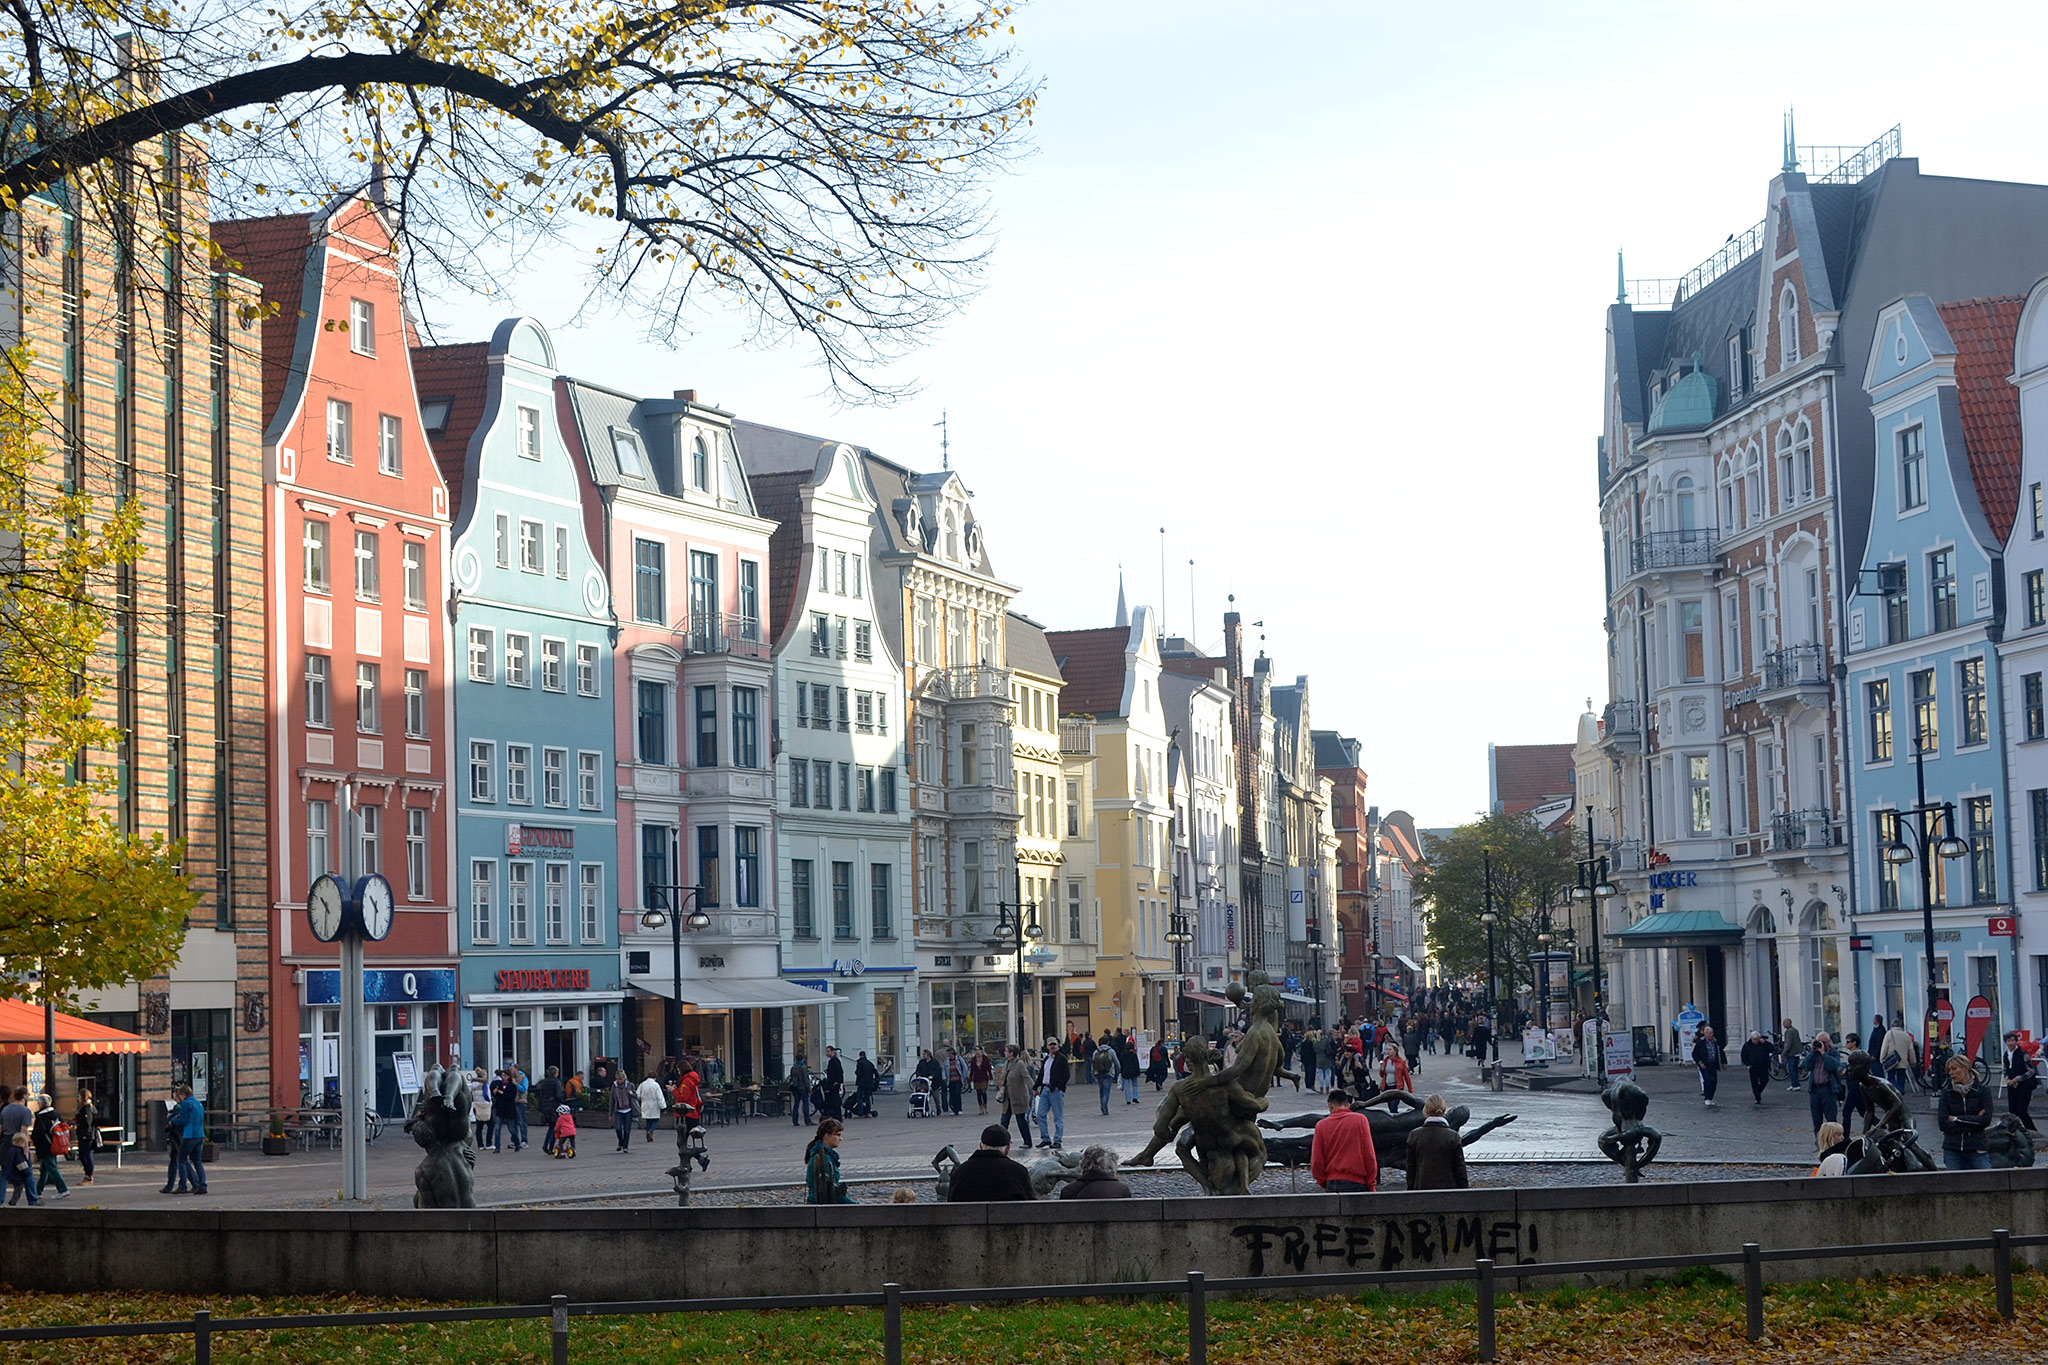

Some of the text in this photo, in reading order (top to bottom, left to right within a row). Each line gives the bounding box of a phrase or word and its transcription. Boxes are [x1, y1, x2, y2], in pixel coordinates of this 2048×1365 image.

[520, 826, 575, 849] GENERALI
[698, 957, 725, 968] BONITA
[983, 1030, 1003, 1039] SALE
